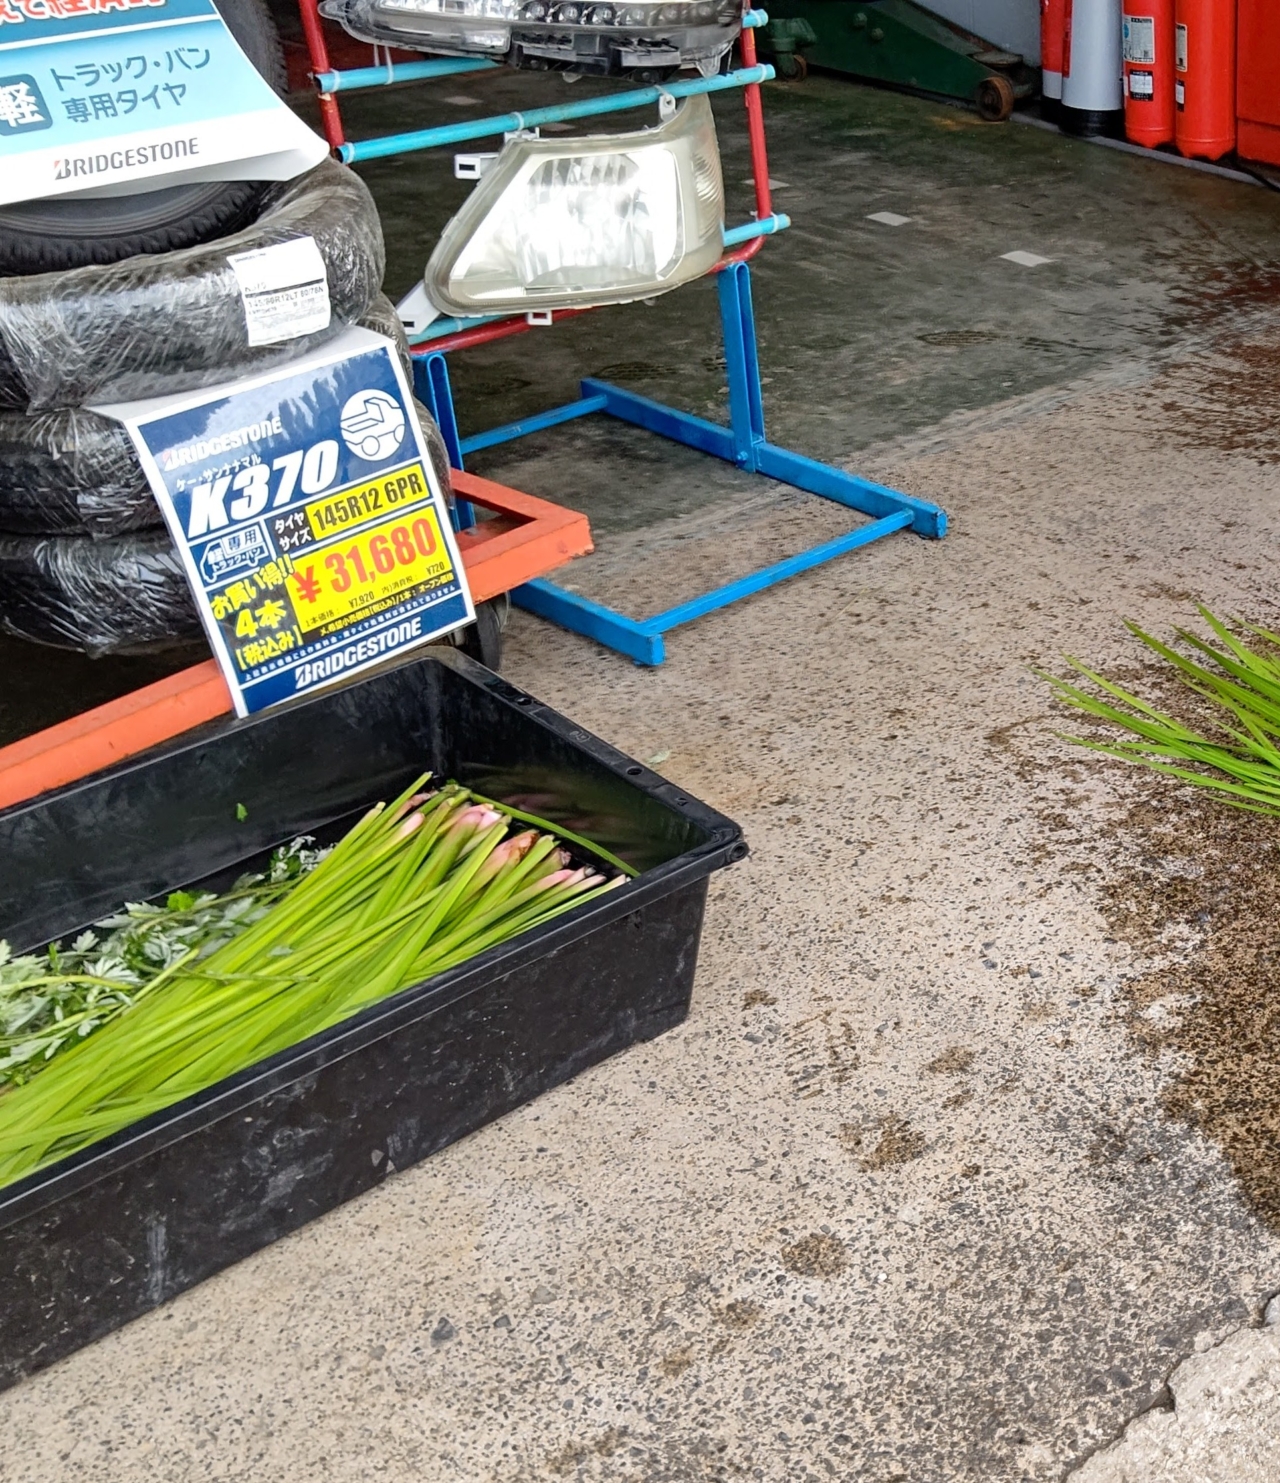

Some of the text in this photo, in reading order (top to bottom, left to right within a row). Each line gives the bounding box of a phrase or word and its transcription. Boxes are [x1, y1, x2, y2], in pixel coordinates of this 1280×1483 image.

[50, 47, 210, 91] トラック・バン
[0, 81, 46, 128] 軽
[61, 82, 187, 123] 専用タイヤ
[54, 138, 200, 180] BRIDGESTONE
[162, 416, 283, 471] BRIDGESTONE
[188, 439, 339, 538] K370
[313, 472, 423, 531] 145R12 6PR
[275, 512, 304, 534] タイヤ
[279, 527, 312, 551] サイズ
[324, 518, 437, 593] 31,680
[235, 600, 287, 638] 4本
[295, 617, 422, 690] BRIDGESTONE
